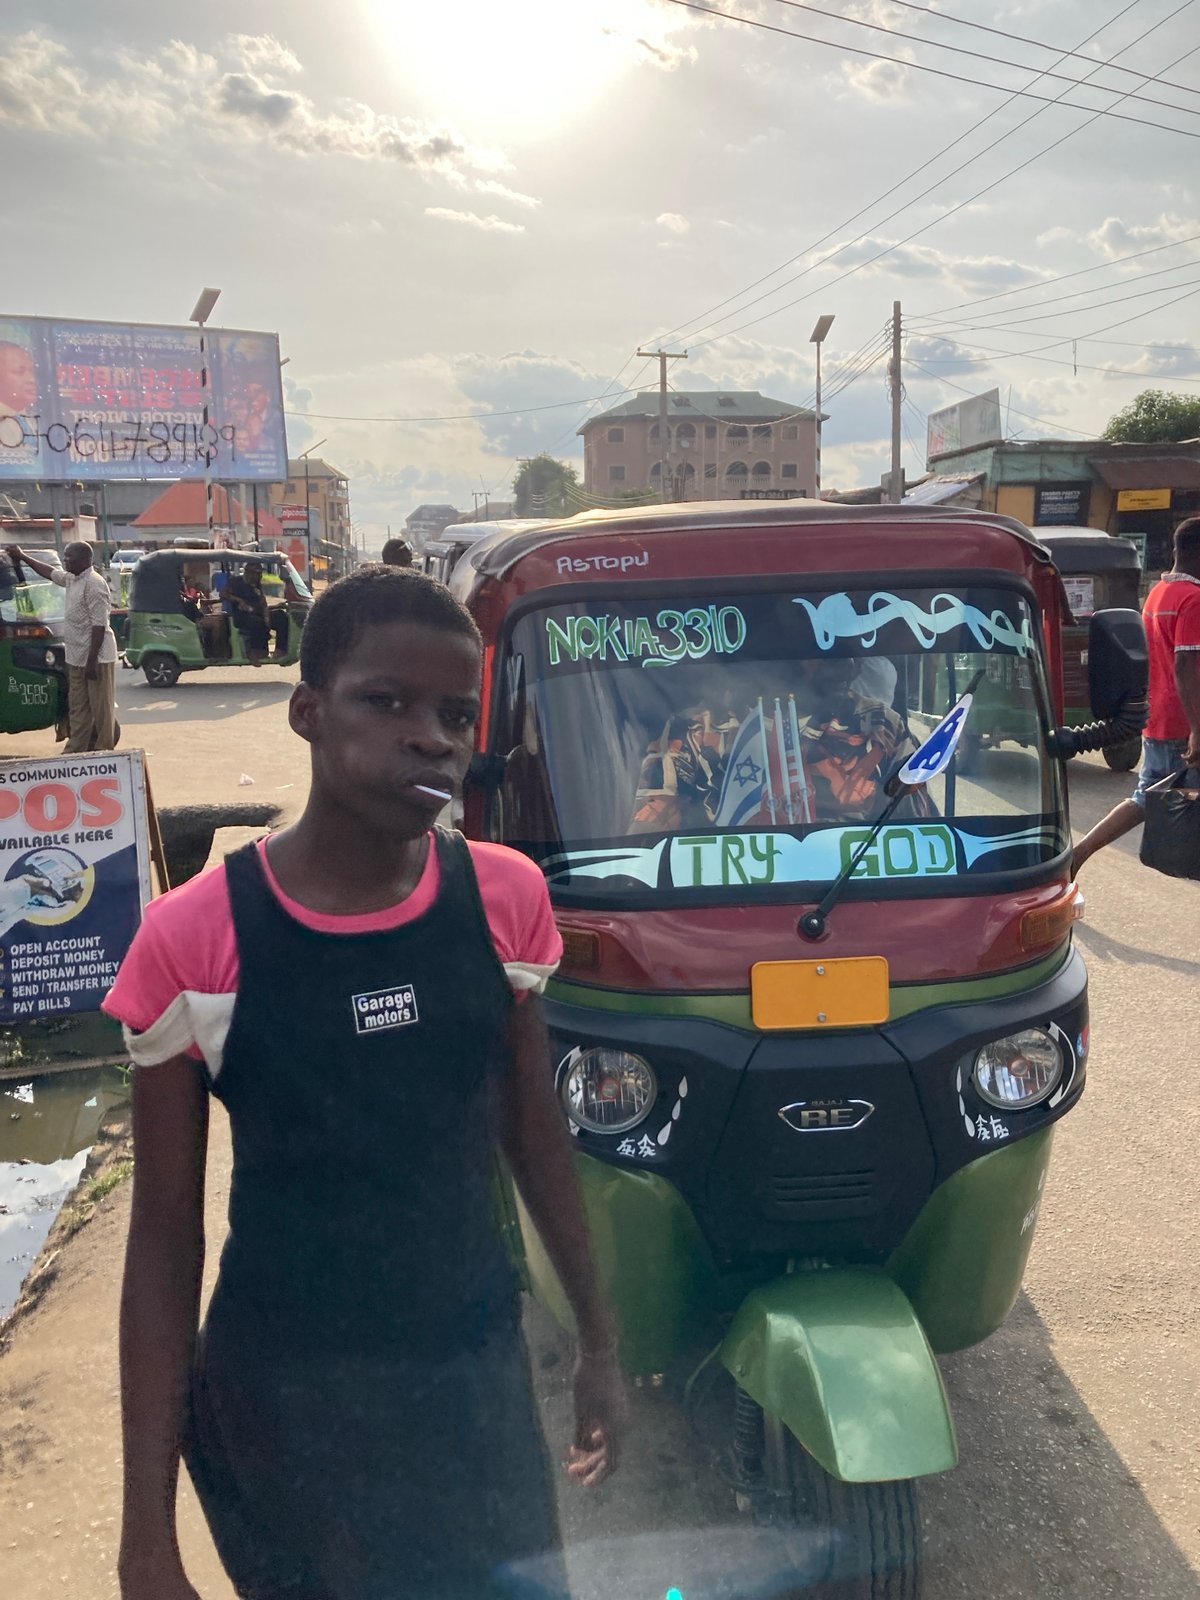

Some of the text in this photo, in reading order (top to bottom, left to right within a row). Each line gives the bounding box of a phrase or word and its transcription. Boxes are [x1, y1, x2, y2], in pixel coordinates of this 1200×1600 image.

[9, 763, 117, 783] COMMUNICATION
[75, 829, 114, 844] HERE
[677, 825, 955, 885] TRY GOD
[10, 936, 101, 956] OPEN ACCOUNT
[11, 949, 105, 970] DEPOSIT MONEY
[12, 961, 119, 983] WITHDRAW MONEY
[12, 984, 39, 998] SEND
[47, 977, 99, 993] TRANSFER
[13, 996, 71, 1014] PAY BILLS
[357, 991, 412, 1012] Garage
[364, 1008, 411, 1028] motors
[800, 1108, 854, 1127] RE
